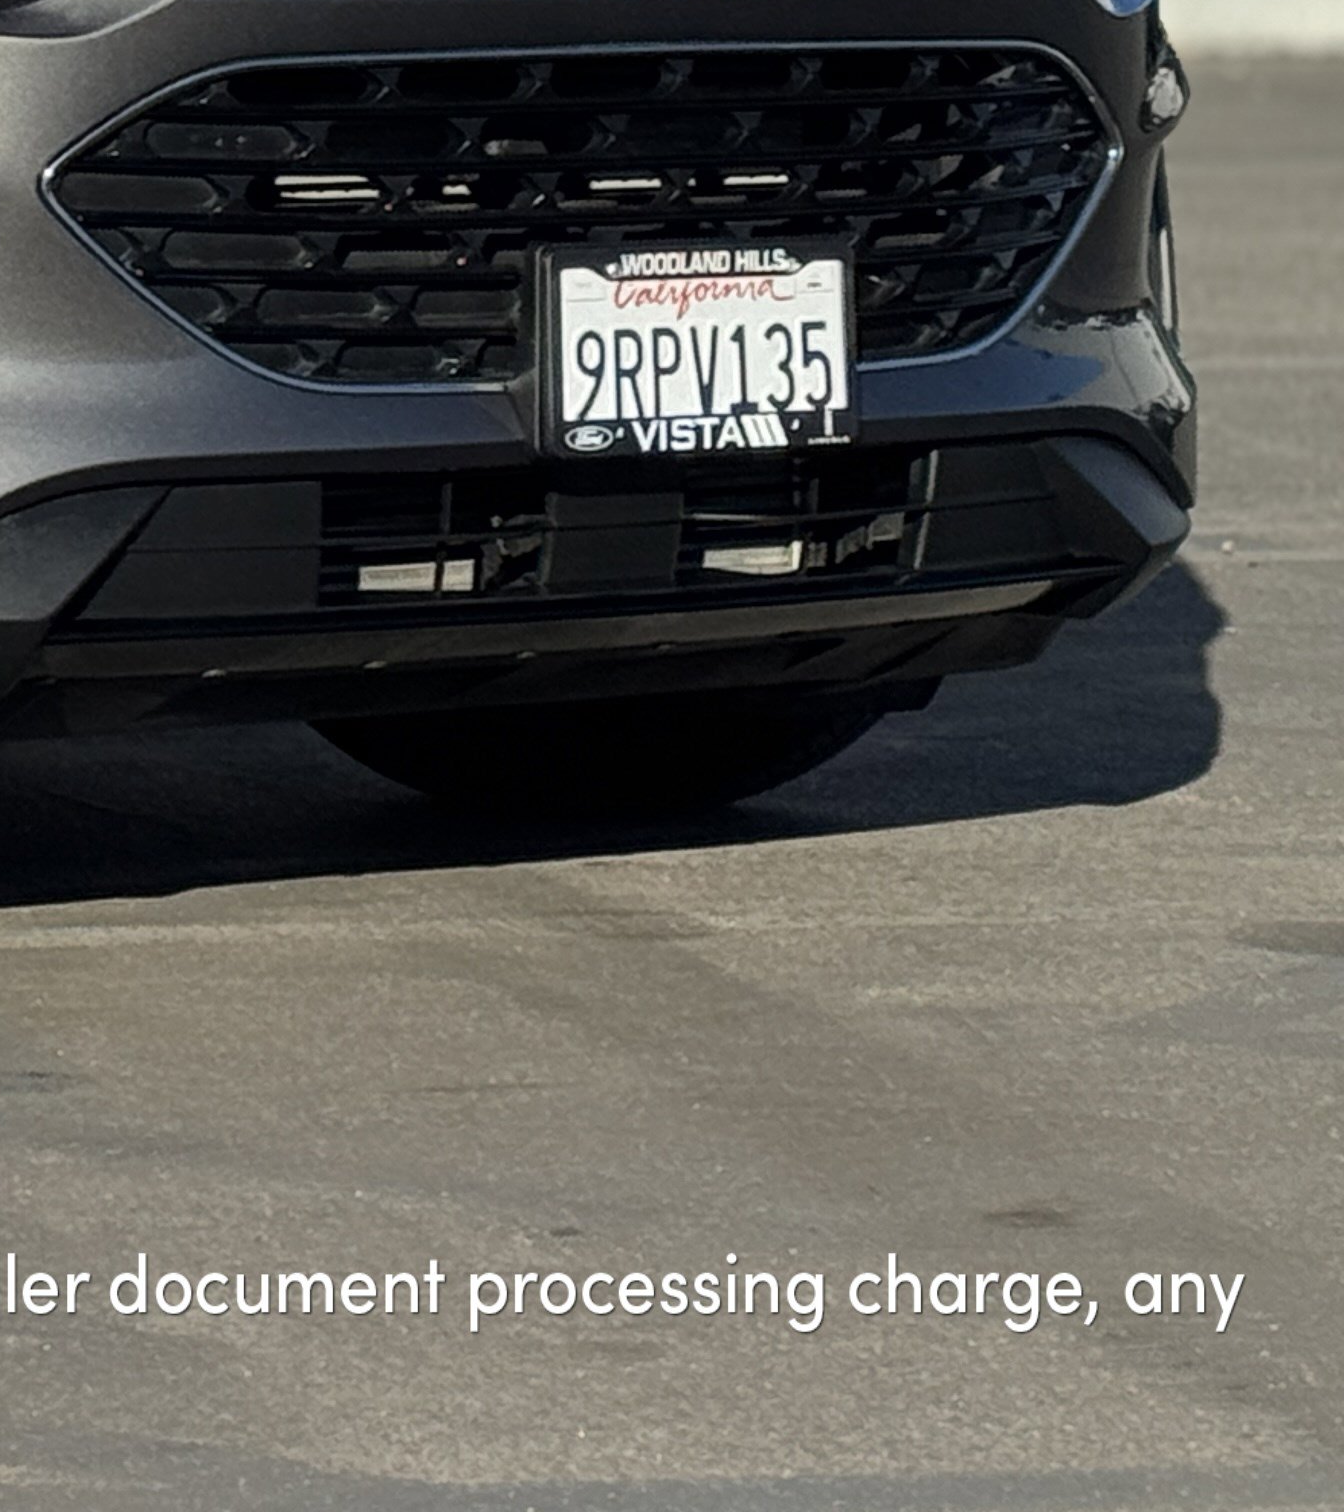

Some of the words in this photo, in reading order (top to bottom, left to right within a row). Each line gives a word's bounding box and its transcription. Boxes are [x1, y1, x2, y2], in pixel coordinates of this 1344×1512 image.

[619, 250, 732, 277] WOODLAND
[734, 248, 788, 273] HILLS
[613, 278, 796, 321] California
[576, 321, 833, 422] 9RPV135
[631, 417, 745, 453] VISTA
